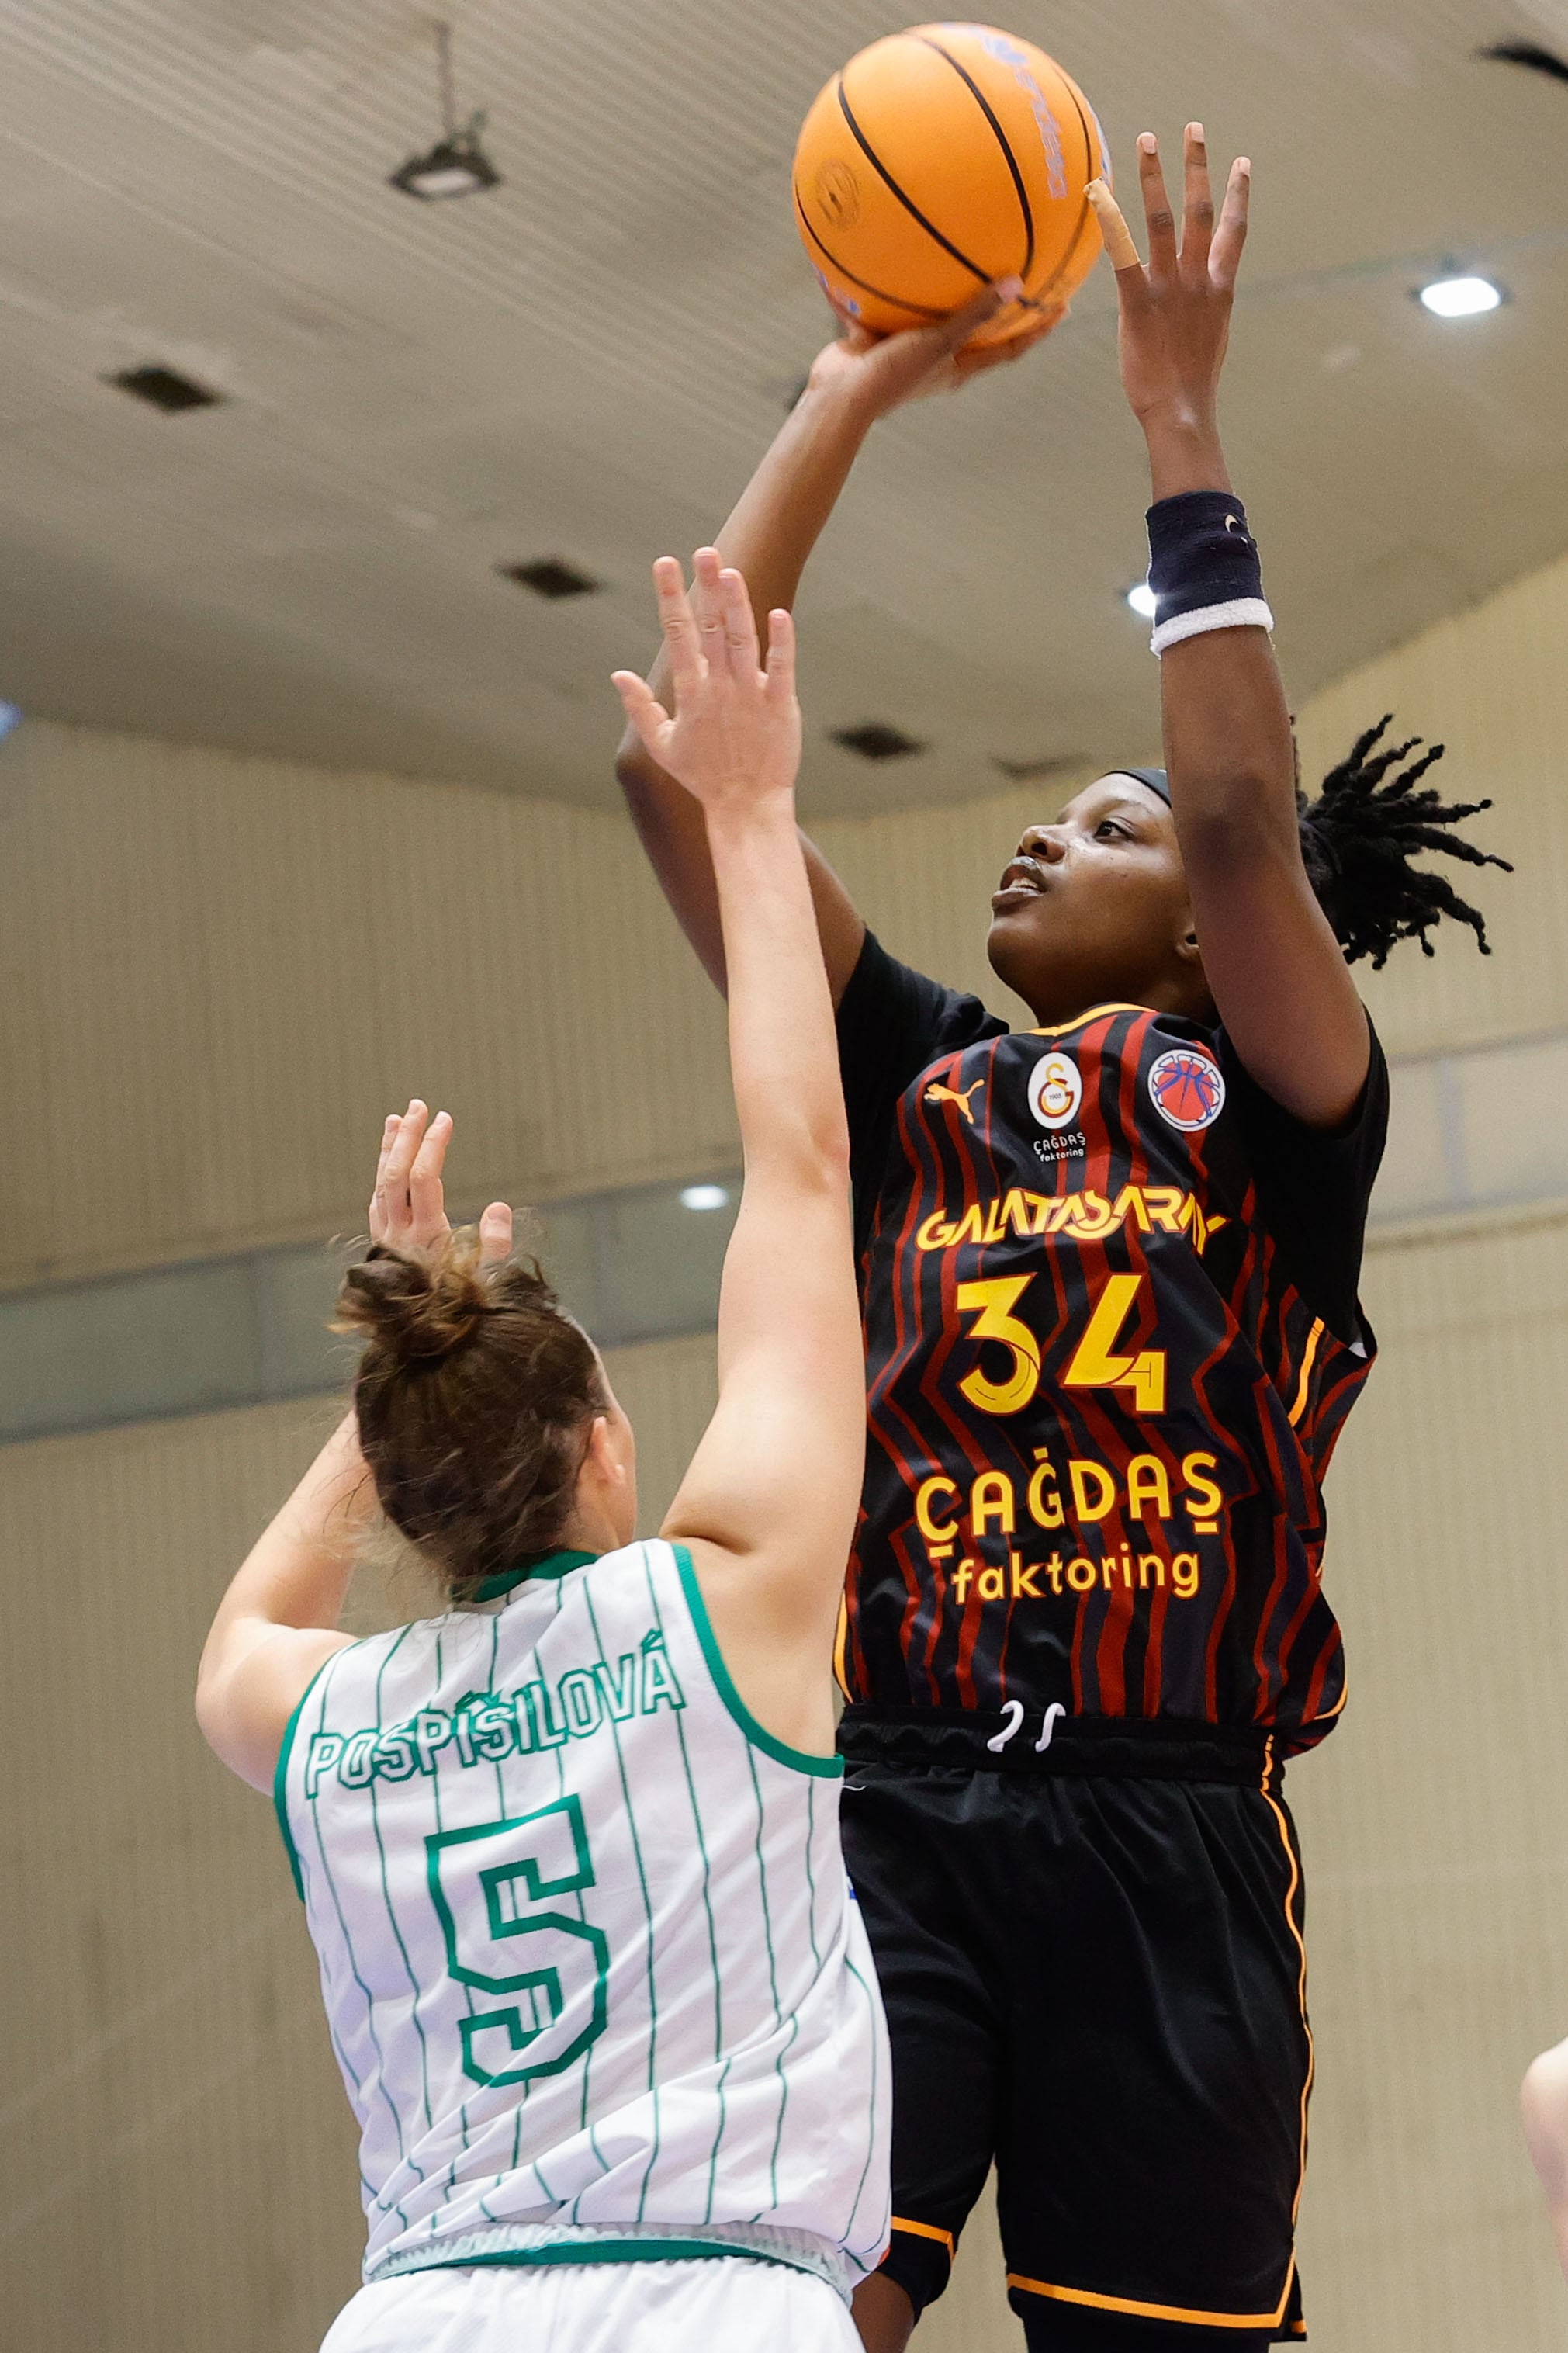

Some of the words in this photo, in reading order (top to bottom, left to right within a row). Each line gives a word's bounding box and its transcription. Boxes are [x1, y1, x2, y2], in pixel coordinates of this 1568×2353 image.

[1033, 1132, 1085, 1155] ÇAĞDAŞ
[916, 1186, 1229, 1256] GALATASARAY
[956, 1273, 1167, 1416] 34
[952, 1543, 1200, 1605] faktoring
[306, 1628, 685, 1799] POSPÍŠILOVÁ
[424, 1793, 609, 2088] 5
